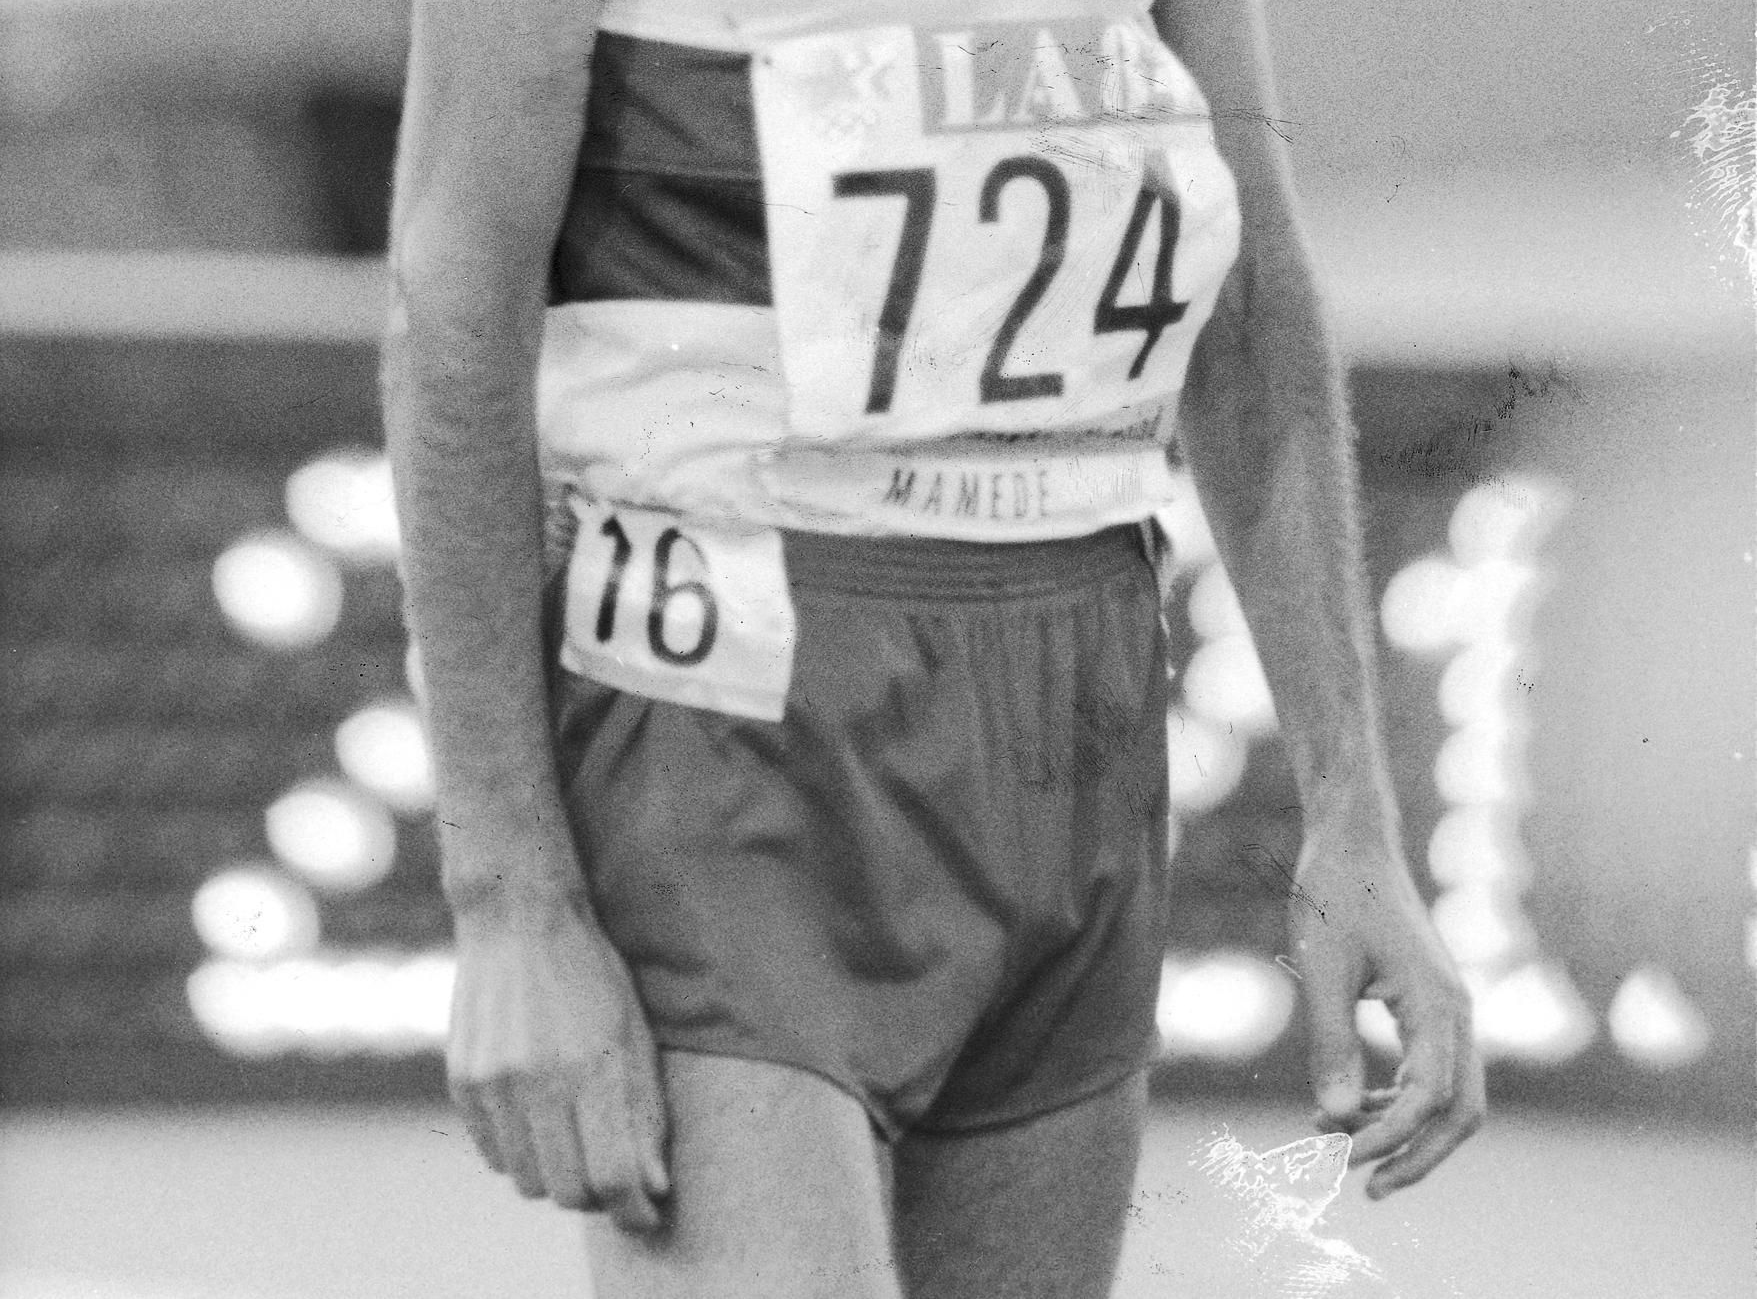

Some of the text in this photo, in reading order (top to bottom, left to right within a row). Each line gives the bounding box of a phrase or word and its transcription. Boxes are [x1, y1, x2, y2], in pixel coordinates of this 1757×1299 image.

[831, 152, 1191, 414] 724
[883, 466, 1050, 519] MAMEDE
[596, 513, 719, 667] 16
